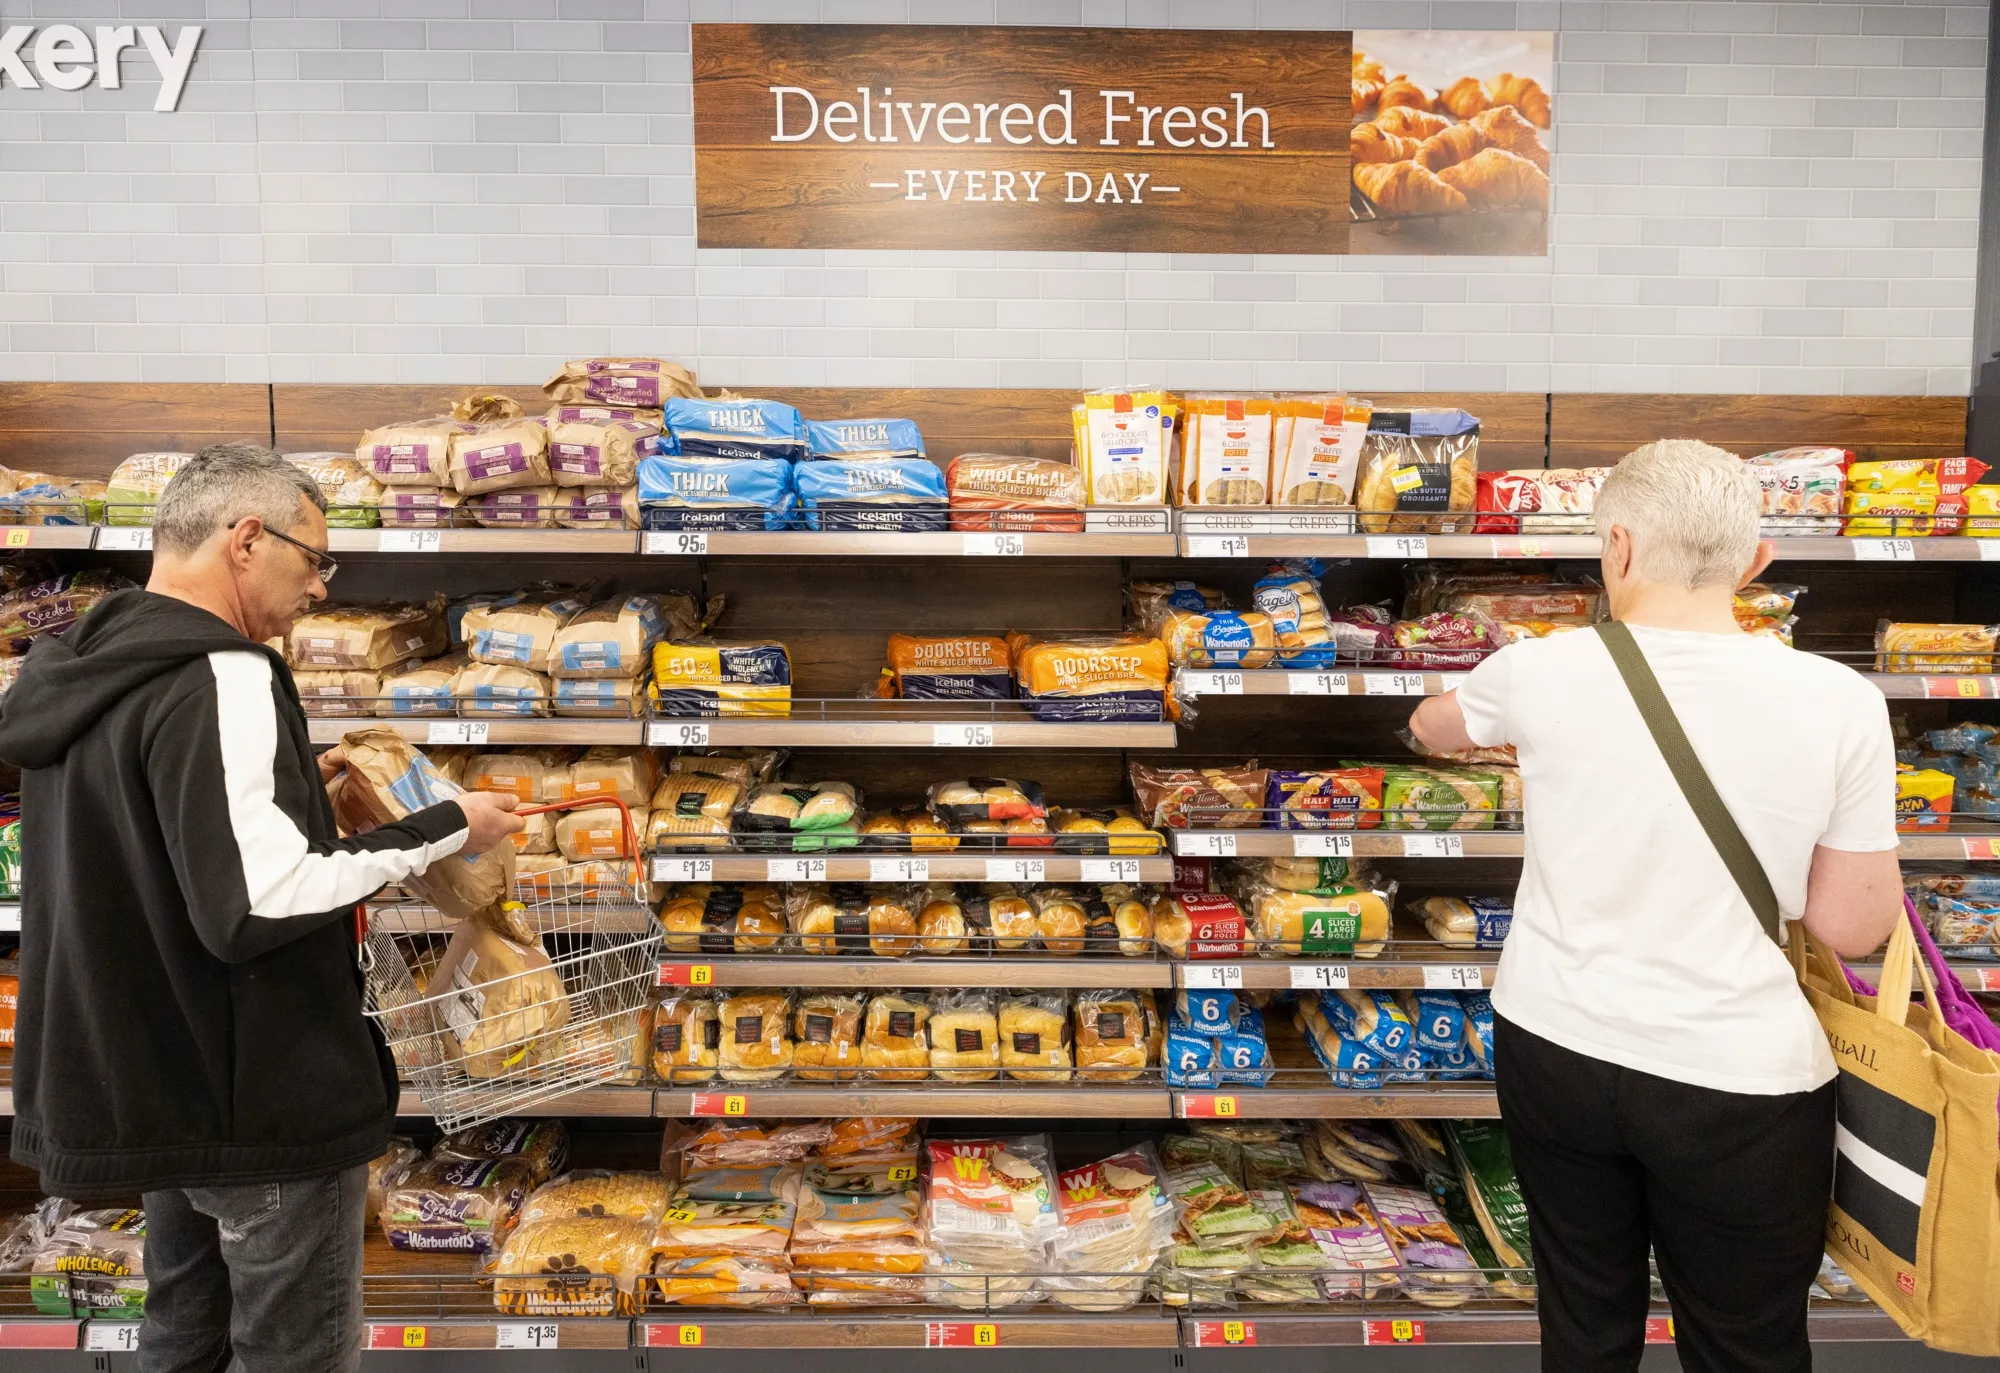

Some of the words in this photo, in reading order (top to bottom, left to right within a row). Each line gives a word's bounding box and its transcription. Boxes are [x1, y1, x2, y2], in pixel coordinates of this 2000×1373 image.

[769, 86, 1073, 146] Delivered
[1099, 91, 1276, 149] Fresh
[904, 171, 1046, 203] EVERY
[1064, 173, 1150, 206] DAY
[708, 408, 766, 428] THICK
[838, 424, 889, 442] THICK
[718, 447, 761, 460] Iceland
[1944, 458, 1967, 468] PACK
[1944, 467, 1967, 476] £1.50
[670, 471, 730, 492] THICK
[844, 468, 905, 487] THICK
[969, 468, 1068, 488] WHOLEMEAL
[968, 481, 996, 492] THICK
[999, 484, 1033, 496] SLICED
[1036, 487, 1068, 499] BREAD
[857, 511, 903, 522] Iceland
[1868, 506, 1916, 517] Soreen
[1935, 503, 1961, 514] FAMILY
[681, 512, 726, 526] Iceland
[857, 523, 874, 531] BEST
[1005, 522, 1033, 531] QUALITY
[1107, 514, 1156, 528] CREPES
[1204, 515, 1254, 529] CREPES
[1289, 516, 1338, 529] CREPES
[1971, 519, 2000, 527] Soreen
[12, 533, 24, 545] £1
[130, 531, 153, 549] £1.2
[409, 531, 439, 550] £1.29
[678, 534, 706, 553] 95p
[994, 535, 1022, 555] 95p
[1222, 540, 1246, 556] £1.25
[1397, 538, 1425, 557] £1.25
[1882, 540, 1911, 559] £1.50
[1257, 590, 1298, 611] Bagels
[1531, 602, 1577, 614] Warburtons
[26, 601, 75, 629] Seeded
[1212, 623, 1243, 637] Bagels
[1429, 622, 1449, 641] FRUIT
[1449, 620, 1472, 636] LOAF
[914, 641, 992, 659] DOORSTEP
[1205, 635, 1250, 649] Warburtons
[732, 656, 755, 666] WHITE
[914, 659, 939, 667] WHITE
[940, 659, 967, 667] SLICED
[968, 658, 993, 666] BREAD
[1053, 655, 1142, 677] DOORSTEP
[935, 677, 974, 688] Iceland
[1084, 673, 1115, 683] SLICED
[1212, 674, 1241, 693] £1.60
[1318, 674, 1346, 694] £1.60
[1393, 675, 1422, 694] £1.60
[1963, 683, 1975, 695] £1
[458, 723, 487, 742] £1.29
[679, 725, 707, 745] 95p
[964, 726, 991, 745] 95p
[1195, 791, 1220, 804] Thins
[1320, 784, 1343, 796] Thins
[1432, 787, 1456, 800] Thins
[1303, 797, 1329, 805] HALF
[1416, 799, 1467, 811] Warburtons
[1209, 835, 1234, 855] £1.15
[1325, 836, 1350, 855] £1.15
[1435, 836, 1461, 856] £1.15
[682, 860, 711, 880] £1.25
[796, 860, 825, 880] £1.25
[899, 860, 927, 880] £1.25
[1015, 860, 1043, 880] £1.25
[1110, 861, 1138, 880] £1.25
[1181, 892, 1199, 903] 6
[1186, 901, 1236, 913] Warburtons
[1199, 923, 1213, 940] 6
[1308, 918, 1326, 939] 4
[1328, 919, 1356, 927] SLICED
[1482, 921, 1494, 937] 4
[1197, 942, 1238, 953] Warburtons
[696, 971, 707, 982] £1
[1212, 967, 1240, 987] £1.50
[1316, 967, 1346, 987] £1.40
[1451, 968, 1479, 988] £1.25
[1202, 998, 1220, 1021] 6
[1193, 1020, 1231, 1032] Warburtons
[1432, 1016, 1452, 1038] 6
[1170, 1033, 1211, 1050] Warburtons
[1385, 1026, 1405, 1048] 6
[1180, 1051, 1198, 1071] 6
[1233, 1047, 1251, 1068] 6
[1353, 1052, 1371, 1074] 6
[1403, 1049, 1421, 1070] 6
[730, 1101, 741, 1112] £1
[1220, 1102, 1231, 1113] £1
[953, 1146, 982, 1159] W
[894, 1169, 911, 1179] £1
[953, 1158, 984, 1180] W
[1064, 1171, 1094, 1190] W
[735, 1191, 743, 1200] 8
[852, 1196, 859, 1204] 8
[1067, 1186, 1098, 1203] W
[419, 1199, 470, 1222] Seeded
[668, 1210, 688, 1222] £1
[408, 1230, 475, 1249] Warburtons
[55, 1256, 131, 1277] WHOLEMEAL
[527, 1292, 614, 1314] Warburtons
[406, 1332, 422, 1345] £1.65
[527, 1325, 557, 1348] £1.35
[685, 1331, 696, 1342] £1
[979, 1330, 990, 1342] £1
